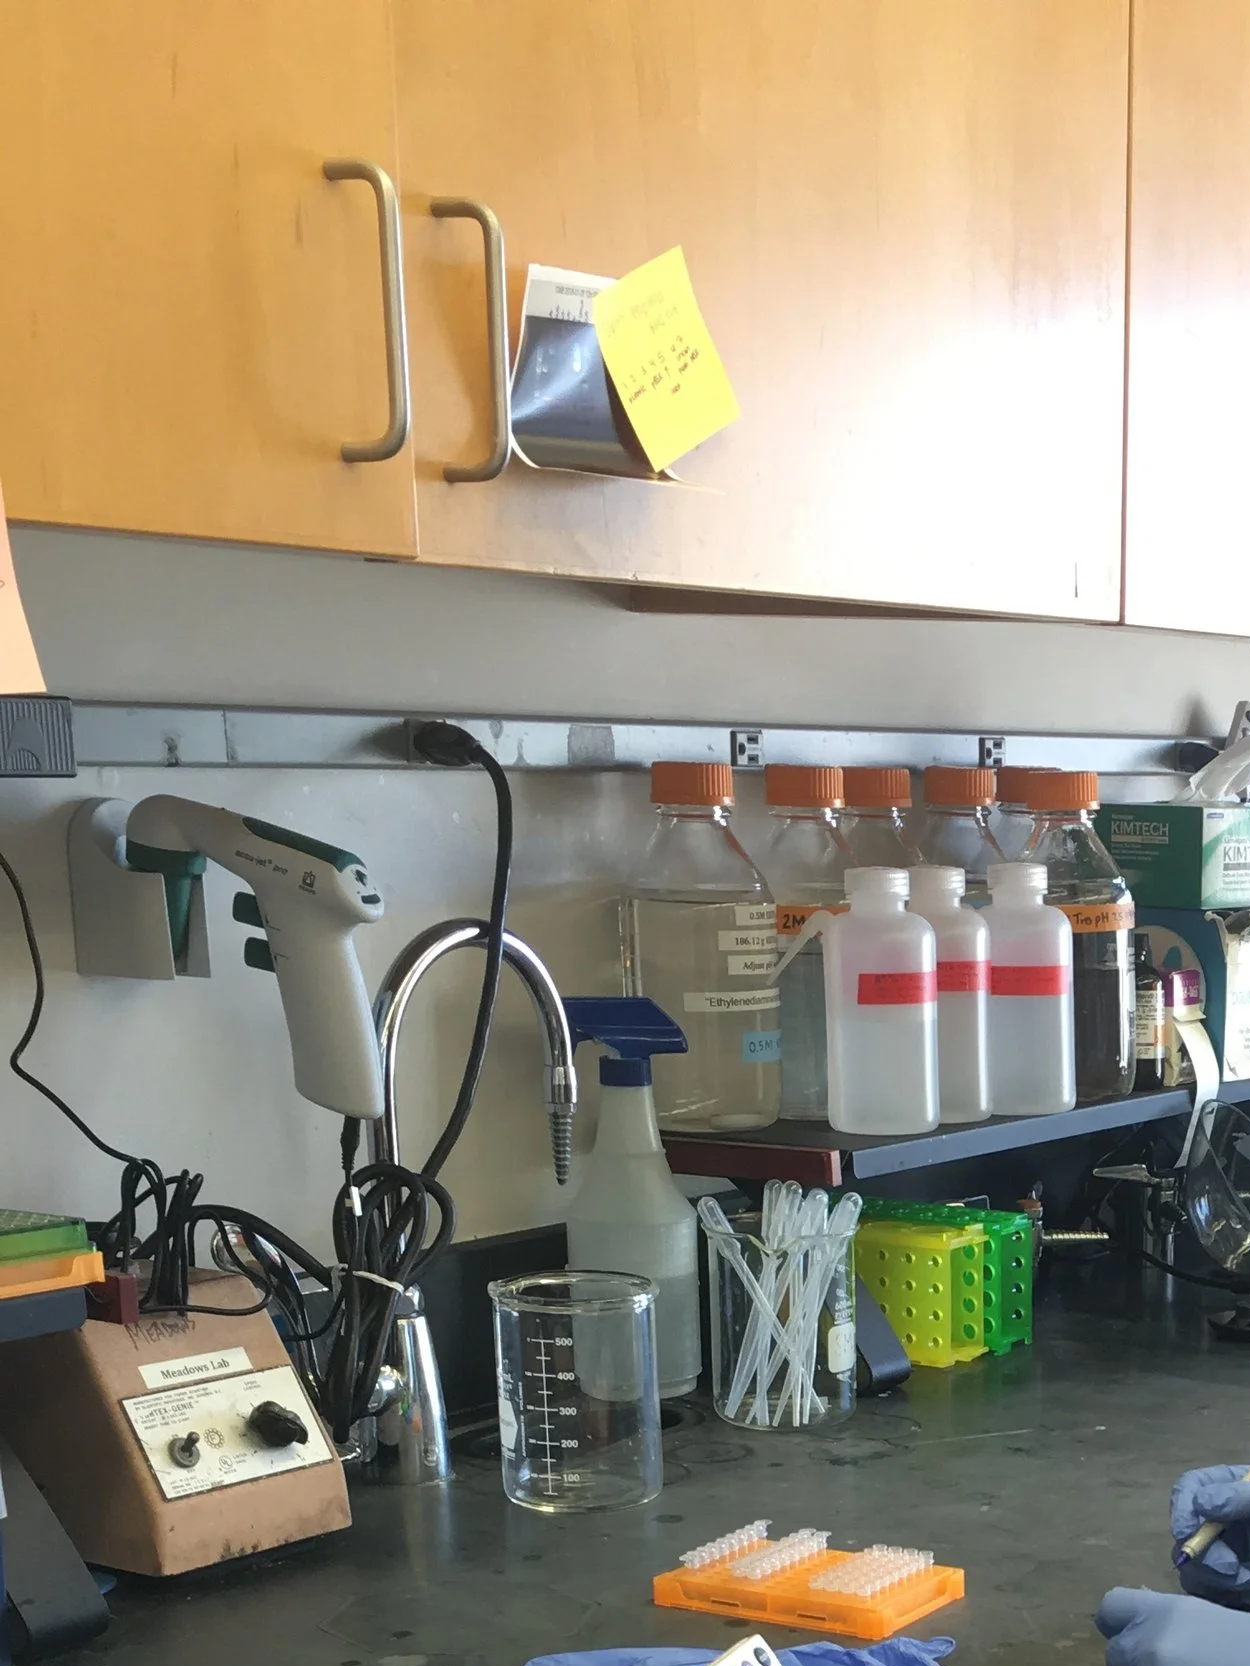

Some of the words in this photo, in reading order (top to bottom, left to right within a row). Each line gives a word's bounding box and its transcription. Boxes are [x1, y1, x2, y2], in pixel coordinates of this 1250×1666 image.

[1111, 821, 1169, 836] KIMTECH
[555, 1337, 573, 1346] 500
[160, 1362, 210, 1380] Meadows
[212, 1358, 230, 1369] Lab
[557, 1372, 575, 1381] 400
[559, 1407, 577, 1416] 300
[561, 1439, 579, 1448] 200
[563, 1473, 580, 1482] 100
